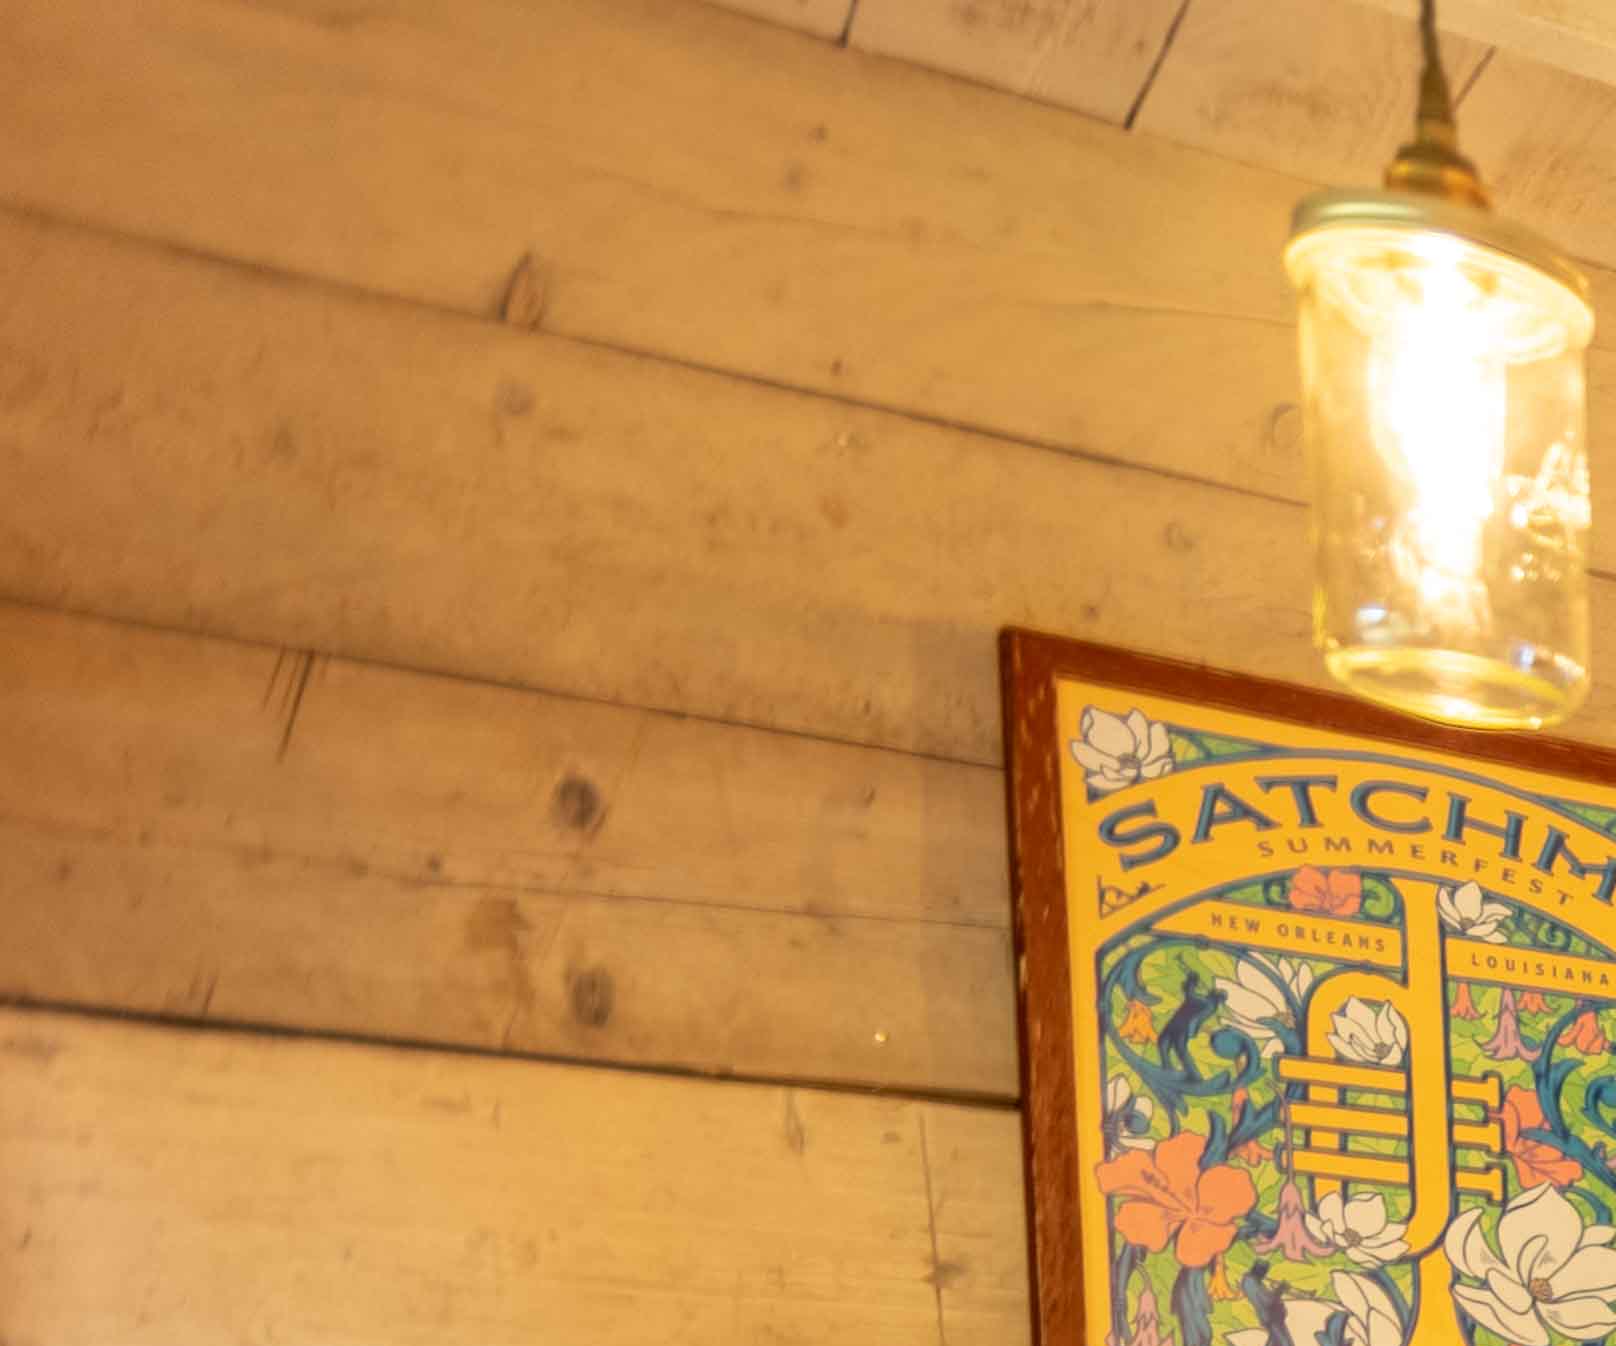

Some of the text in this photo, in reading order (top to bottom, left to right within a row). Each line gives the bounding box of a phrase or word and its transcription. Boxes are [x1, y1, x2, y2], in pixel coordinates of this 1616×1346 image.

[1256, 836, 1575, 906] SUMMERFEST
[1211, 911, 1386, 952] NEW ORLEANS
[1471, 952, 1610, 986] LOUISIANA
